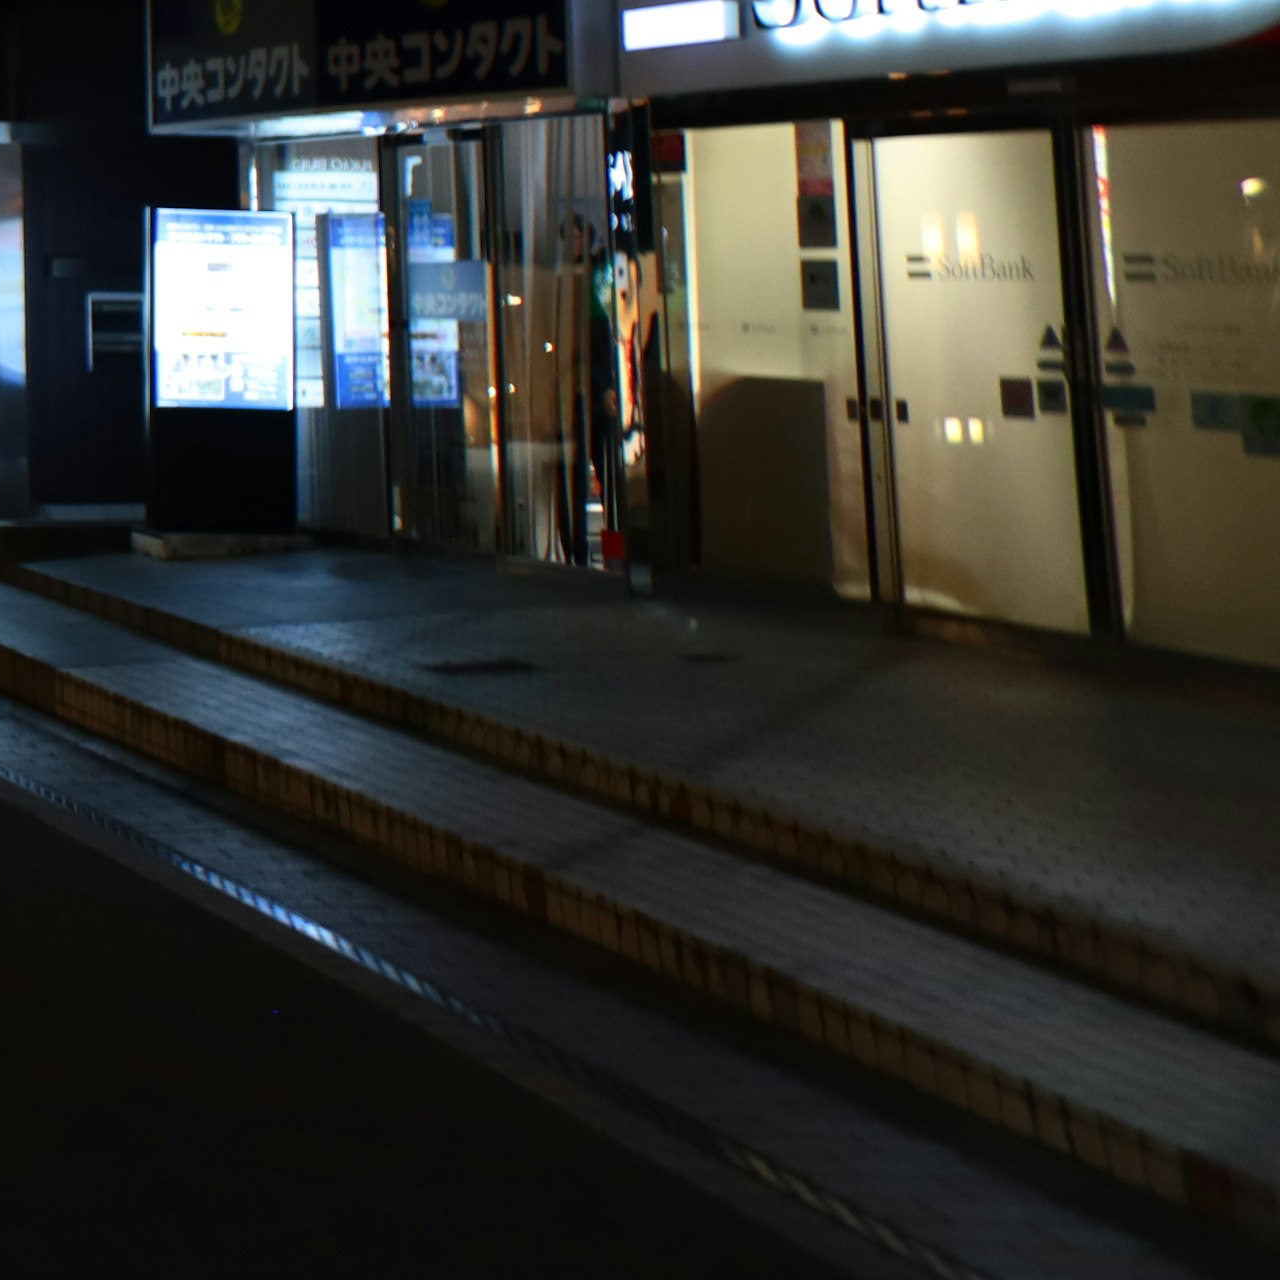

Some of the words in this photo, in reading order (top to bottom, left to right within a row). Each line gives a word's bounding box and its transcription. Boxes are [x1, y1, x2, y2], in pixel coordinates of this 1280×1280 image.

[156, 43, 311, 112] 中央コンタクト
[325, 12, 565, 93] 中央コンタクト
[937, 252, 1035, 281] SoftBank
